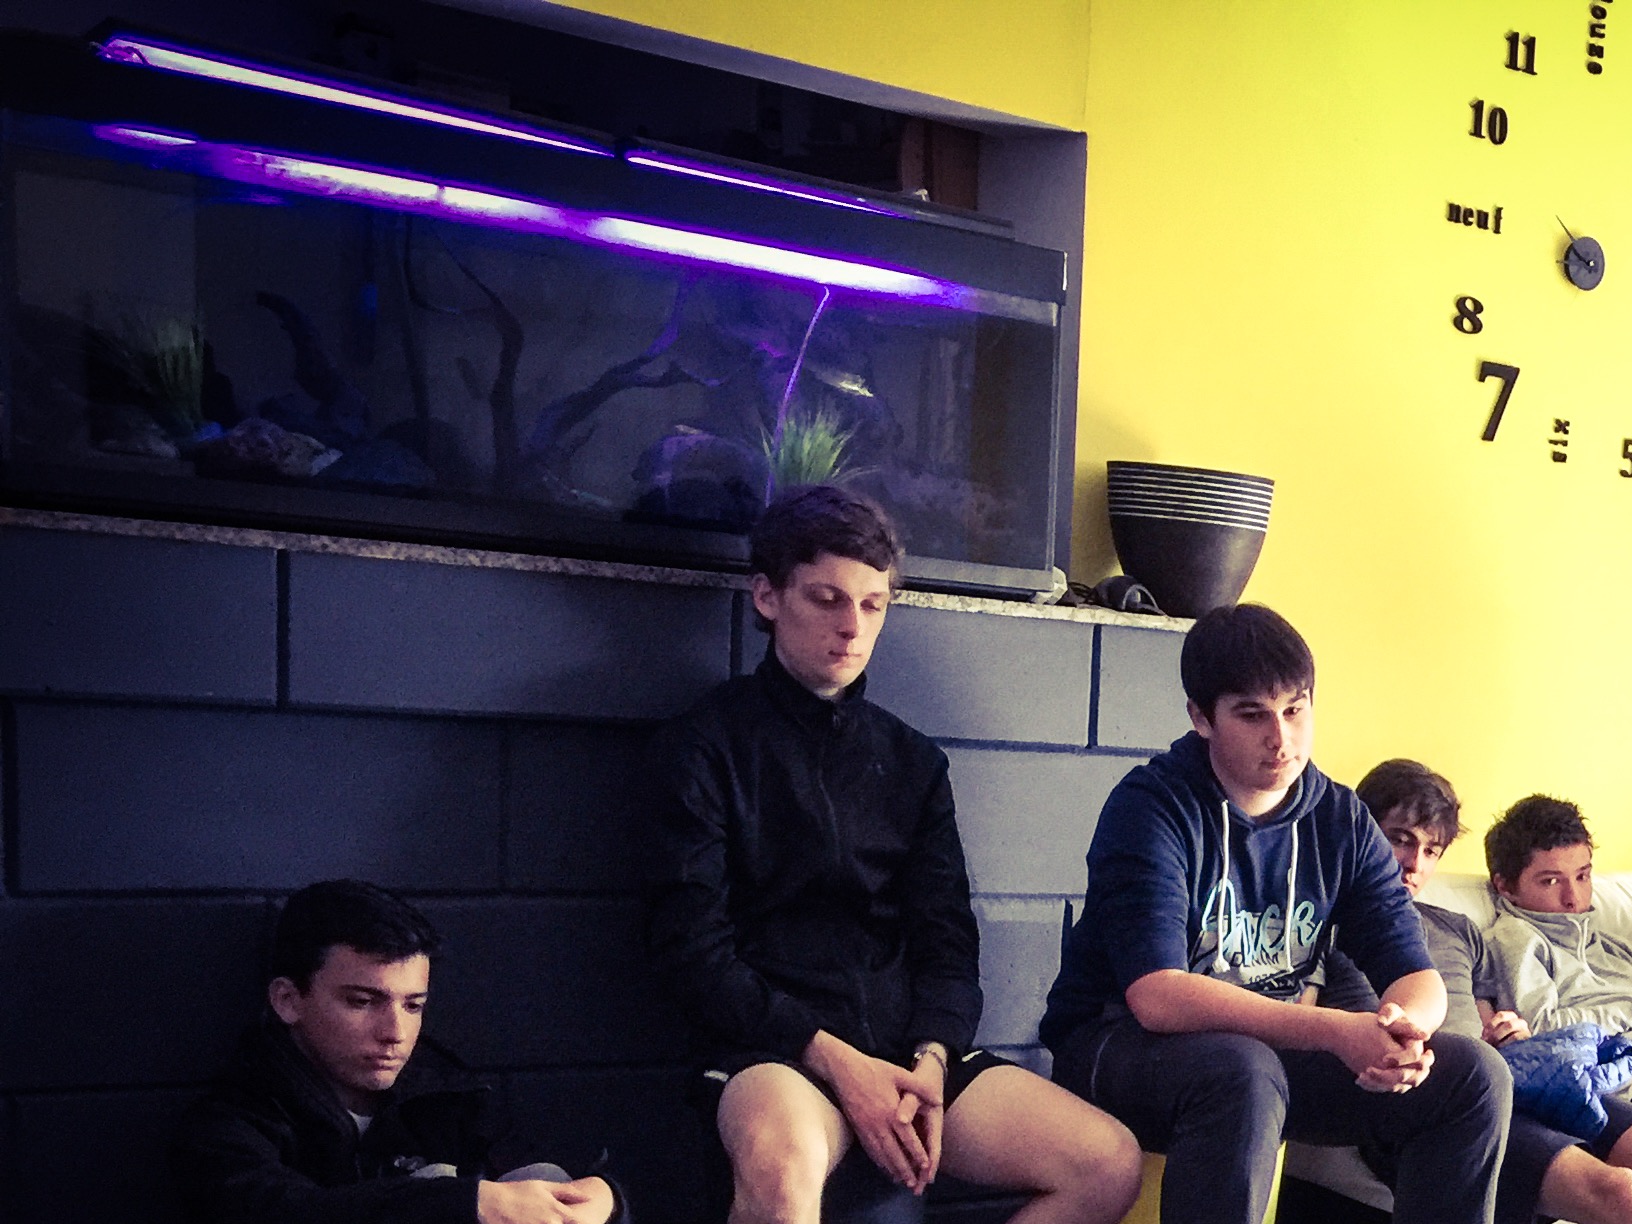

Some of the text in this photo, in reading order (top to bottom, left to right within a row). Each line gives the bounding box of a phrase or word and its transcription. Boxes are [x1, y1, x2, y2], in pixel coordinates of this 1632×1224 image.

[1504, 31, 1538, 76] 11
[1586, 0, 1614, 75] ouze
[1469, 99, 1508, 146] 10
[1446, 202, 1504, 235] neuf
[1452, 296, 1484, 335] 8
[1477, 360, 1521, 442] 7
